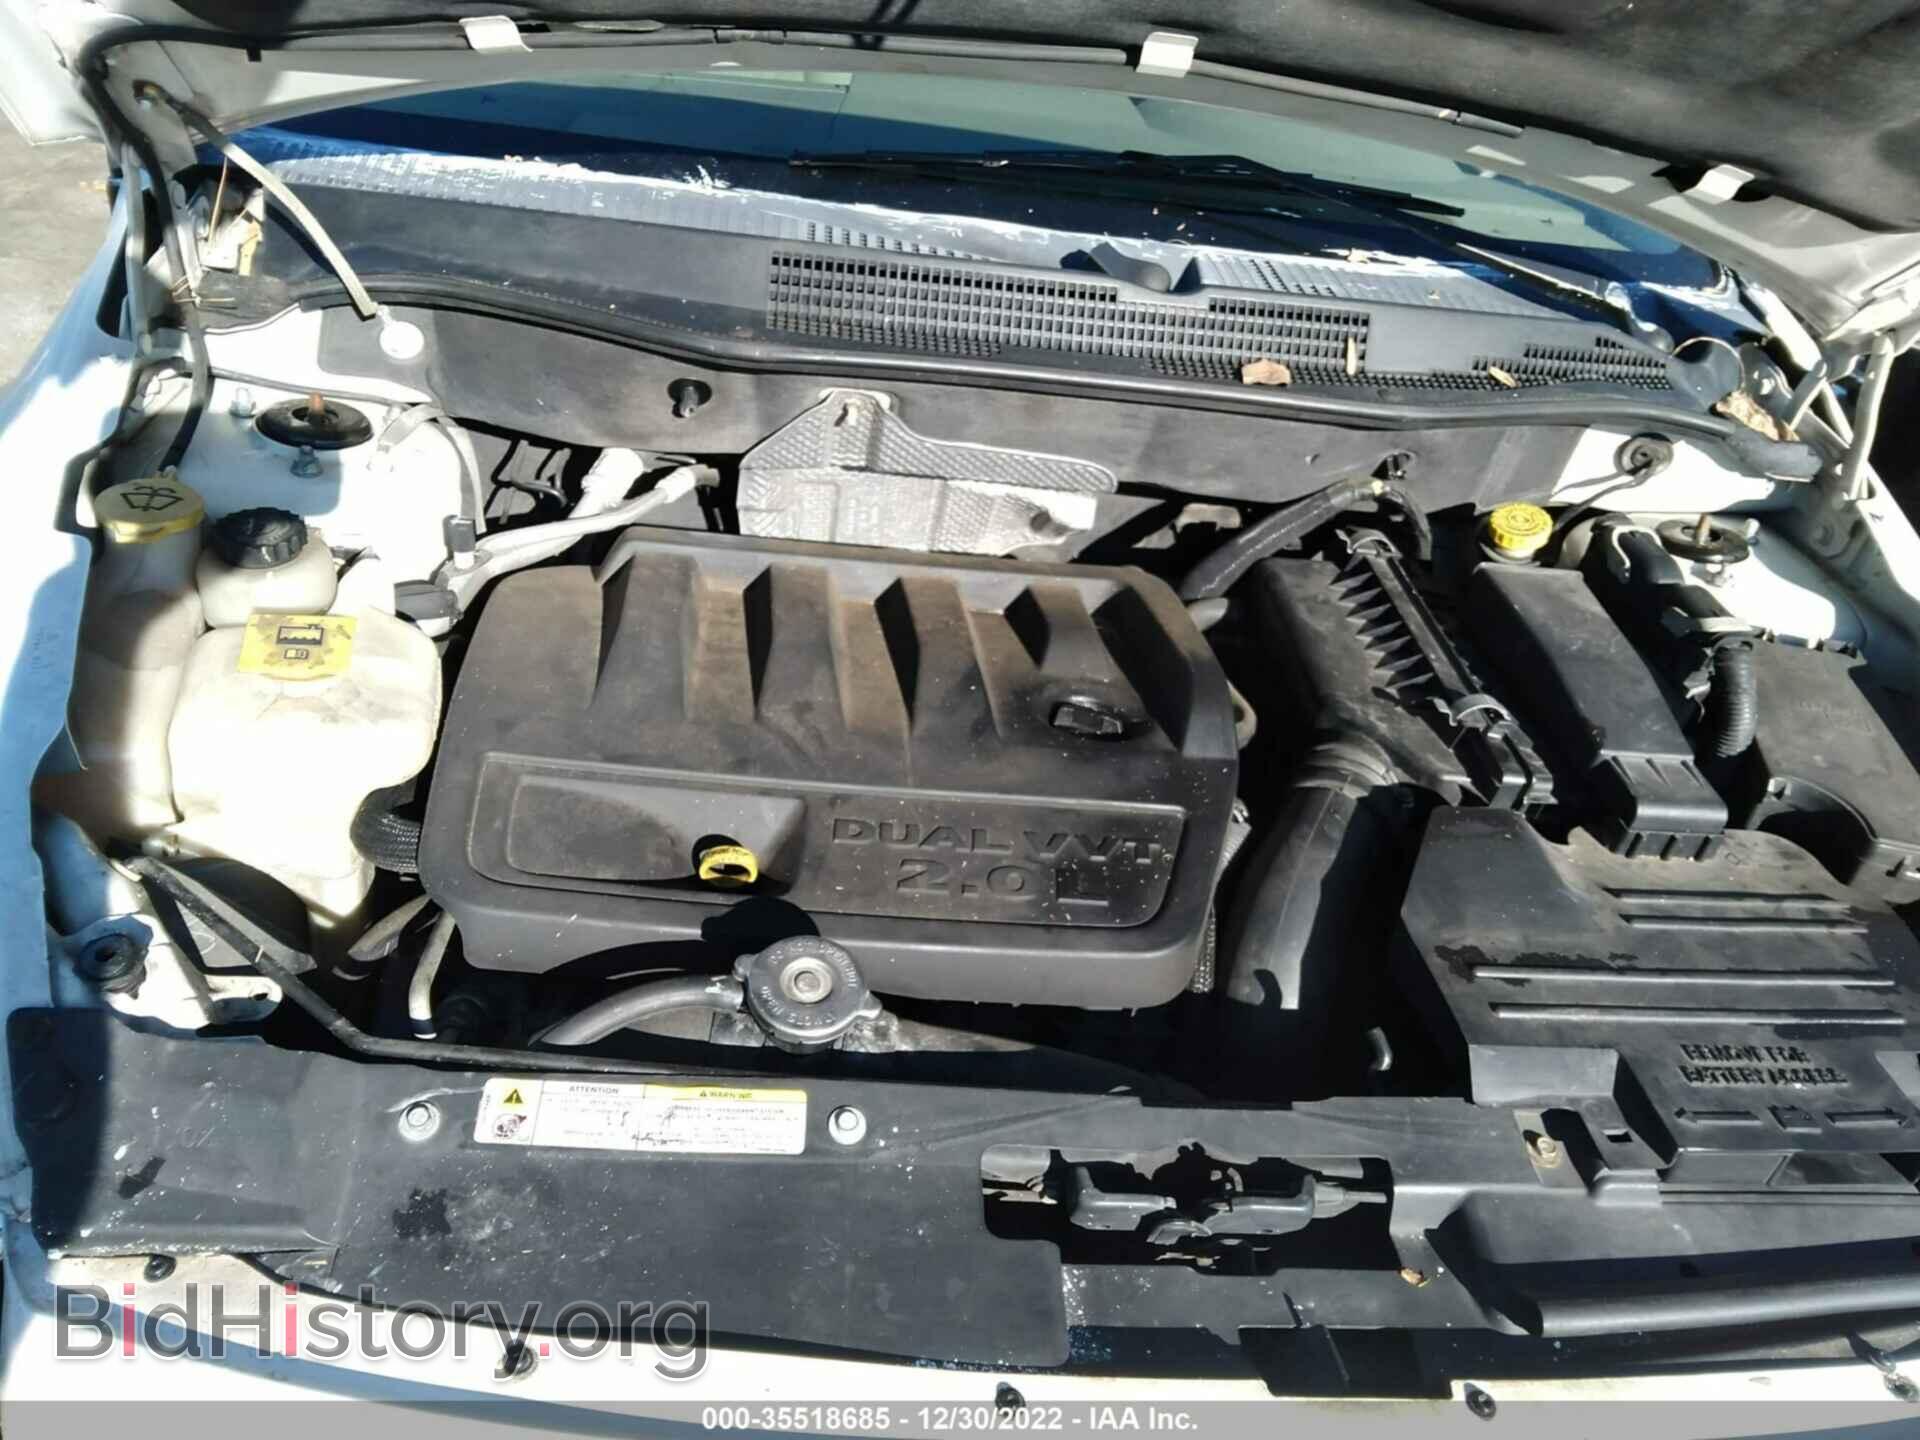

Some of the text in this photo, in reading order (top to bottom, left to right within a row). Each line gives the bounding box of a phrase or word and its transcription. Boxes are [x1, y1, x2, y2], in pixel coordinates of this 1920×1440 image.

[832, 817, 1161, 865] DUAL VVT
[568, 1085, 620, 1095] ATTENTION
[709, 1091, 753, 1099] WARNNG
